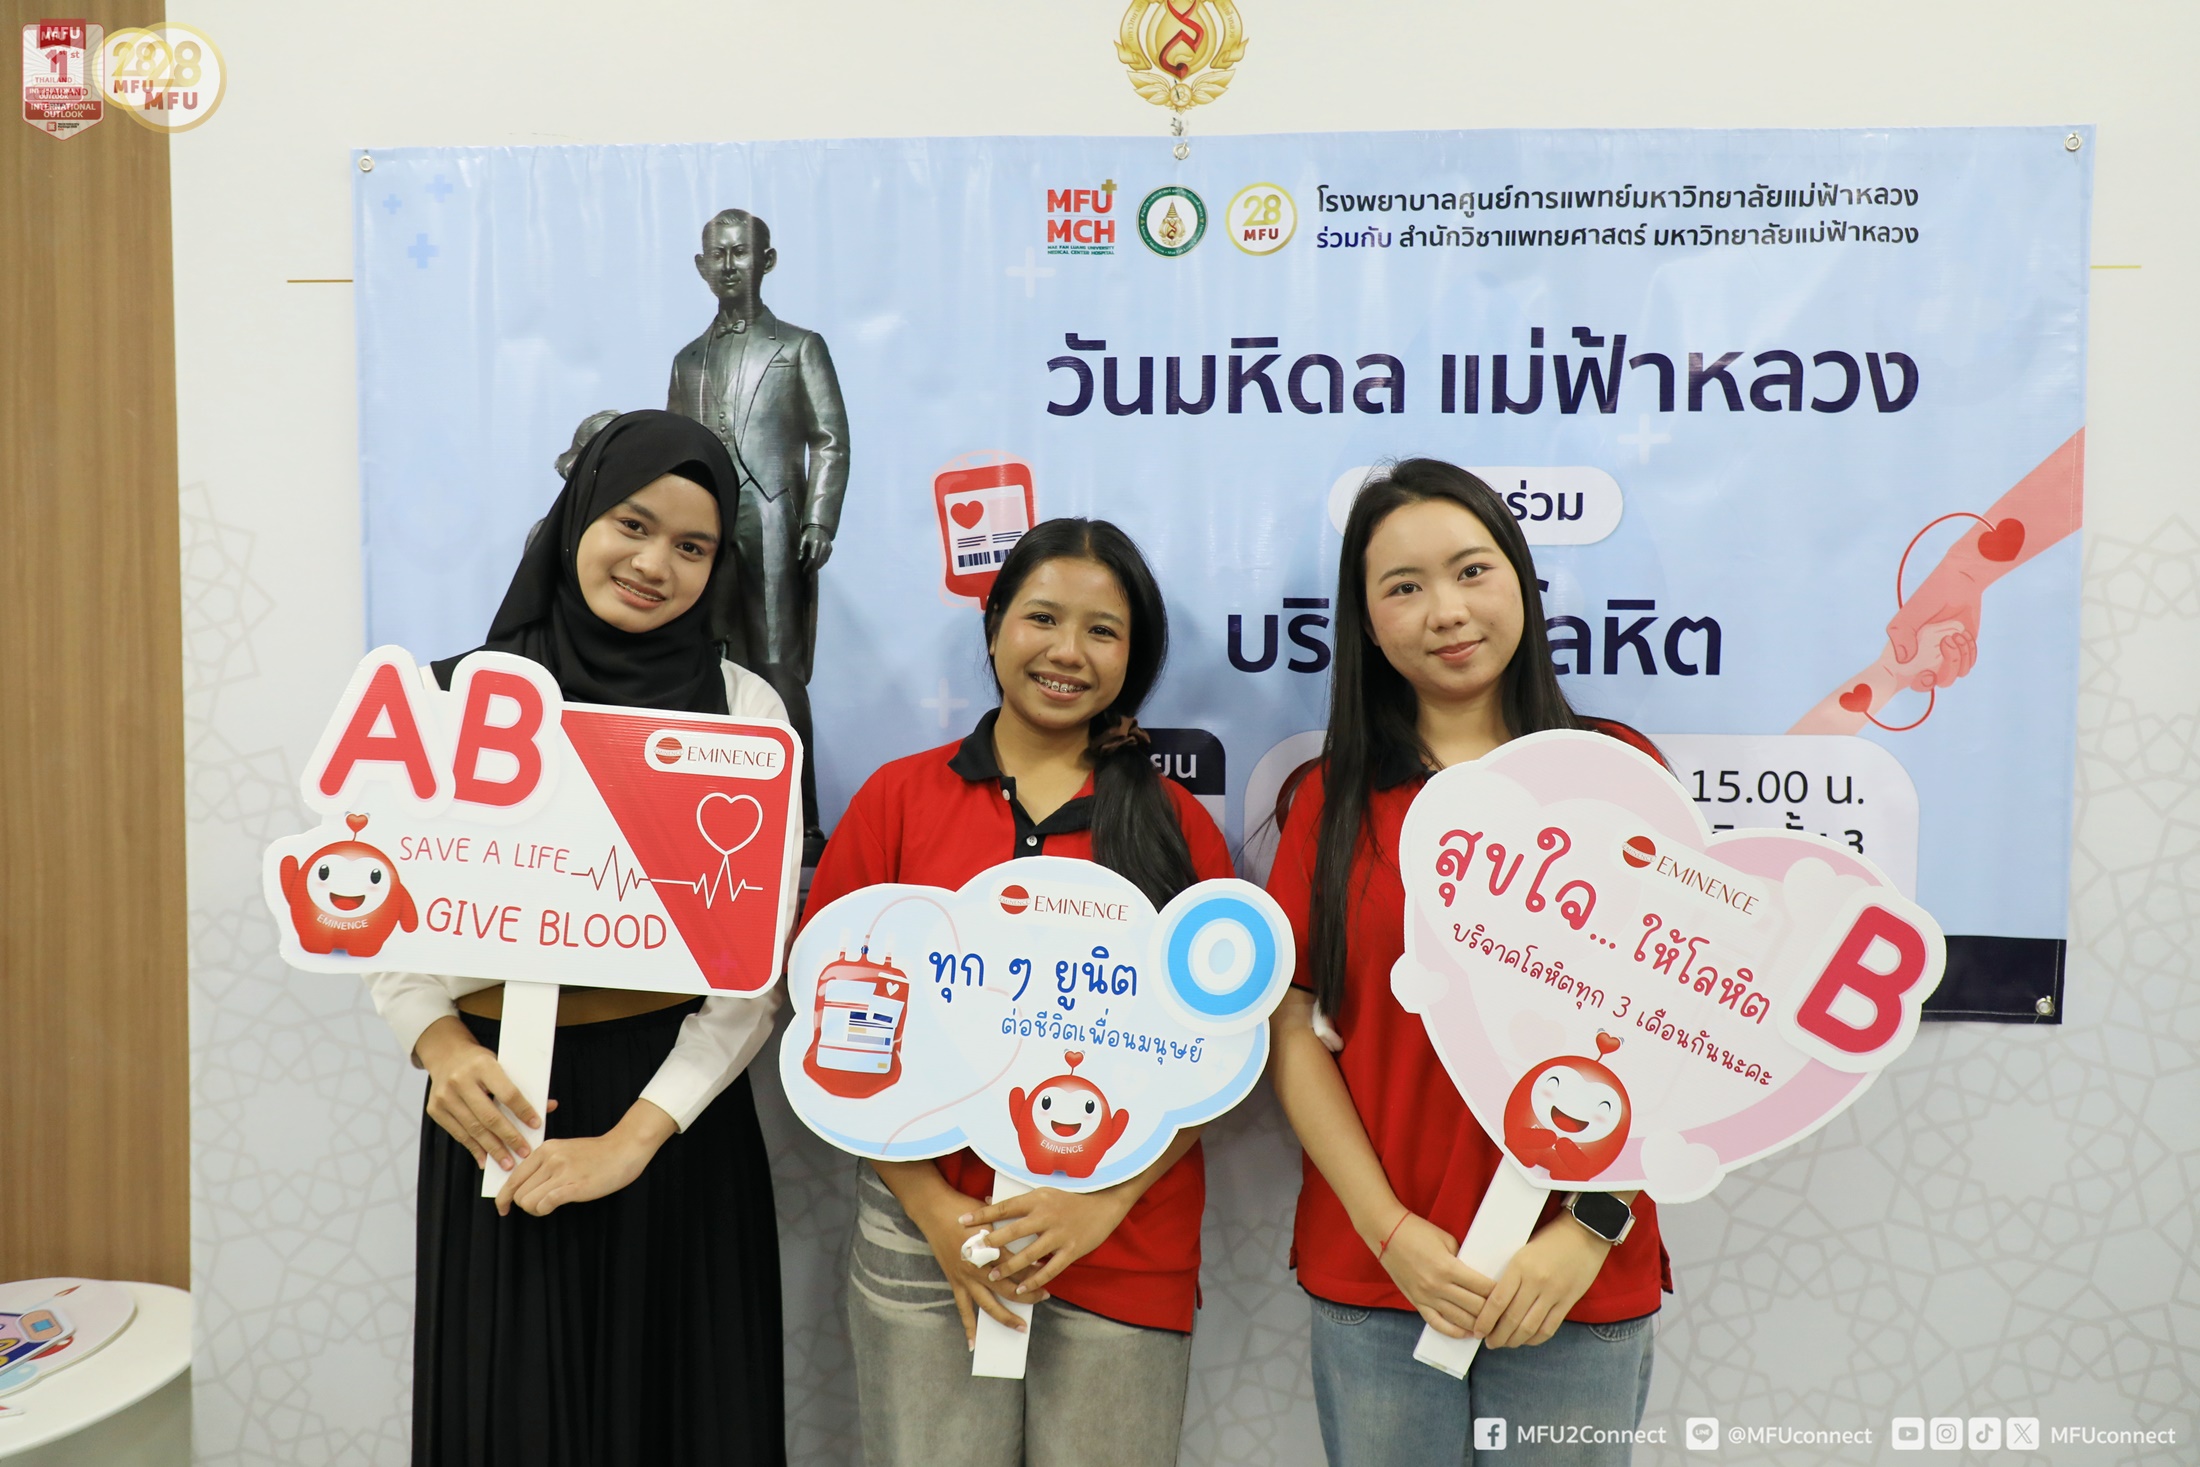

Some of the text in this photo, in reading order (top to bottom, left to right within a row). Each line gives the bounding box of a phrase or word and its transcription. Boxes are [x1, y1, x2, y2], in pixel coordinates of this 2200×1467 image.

[1048, 187, 1113, 214] MFU
[1243, 194, 1281, 226] 28
[1316, 182, 1919, 218] โรงพยาบาลศูนย์การแพทย์มหาวิทยาลัยแม่ฟ้าหลวง
[1047, 219, 1115, 243] MCH
[1244, 228, 1279, 241] MFU
[1316, 219, 1919, 249] ร่วมกับ สำนักวิชาแพทยศาสตร์ มหาวิทยาลัยแม่ฟ้าหลวง
[1046, 326, 1919, 417] วันมหิดล แม่ฟ้าหลวง
[1497, 480, 1584, 521] ร่วม
[319, 663, 545, 807] AB
[687, 746, 777, 768] EMINENCE
[1692, 770, 1865, 805] 15.00 น.
[400, 836, 571, 874] SAVE A LIFE
[1656, 855, 1760, 915] EMINENCE
[316, 914, 369, 930] EMINENCE
[426, 897, 667, 950] GIVE BLOOD
[1034, 895, 1129, 922] EMINENCE
[929, 946, 1138, 1011] ทุก ๆ ยูนิต
[1634, 912, 1771, 1024] ให้โลหิต
[1796, 903, 1927, 1054] B
[1452, 922, 1773, 1086] บริจาคโลหิตทุก 3 เดือนกันนะคะ
[1001, 1008, 1204, 1066] ต่อชีวิตเพื่อนมนุษย์
[1040, 1139, 1084, 1155] EMINENCE
